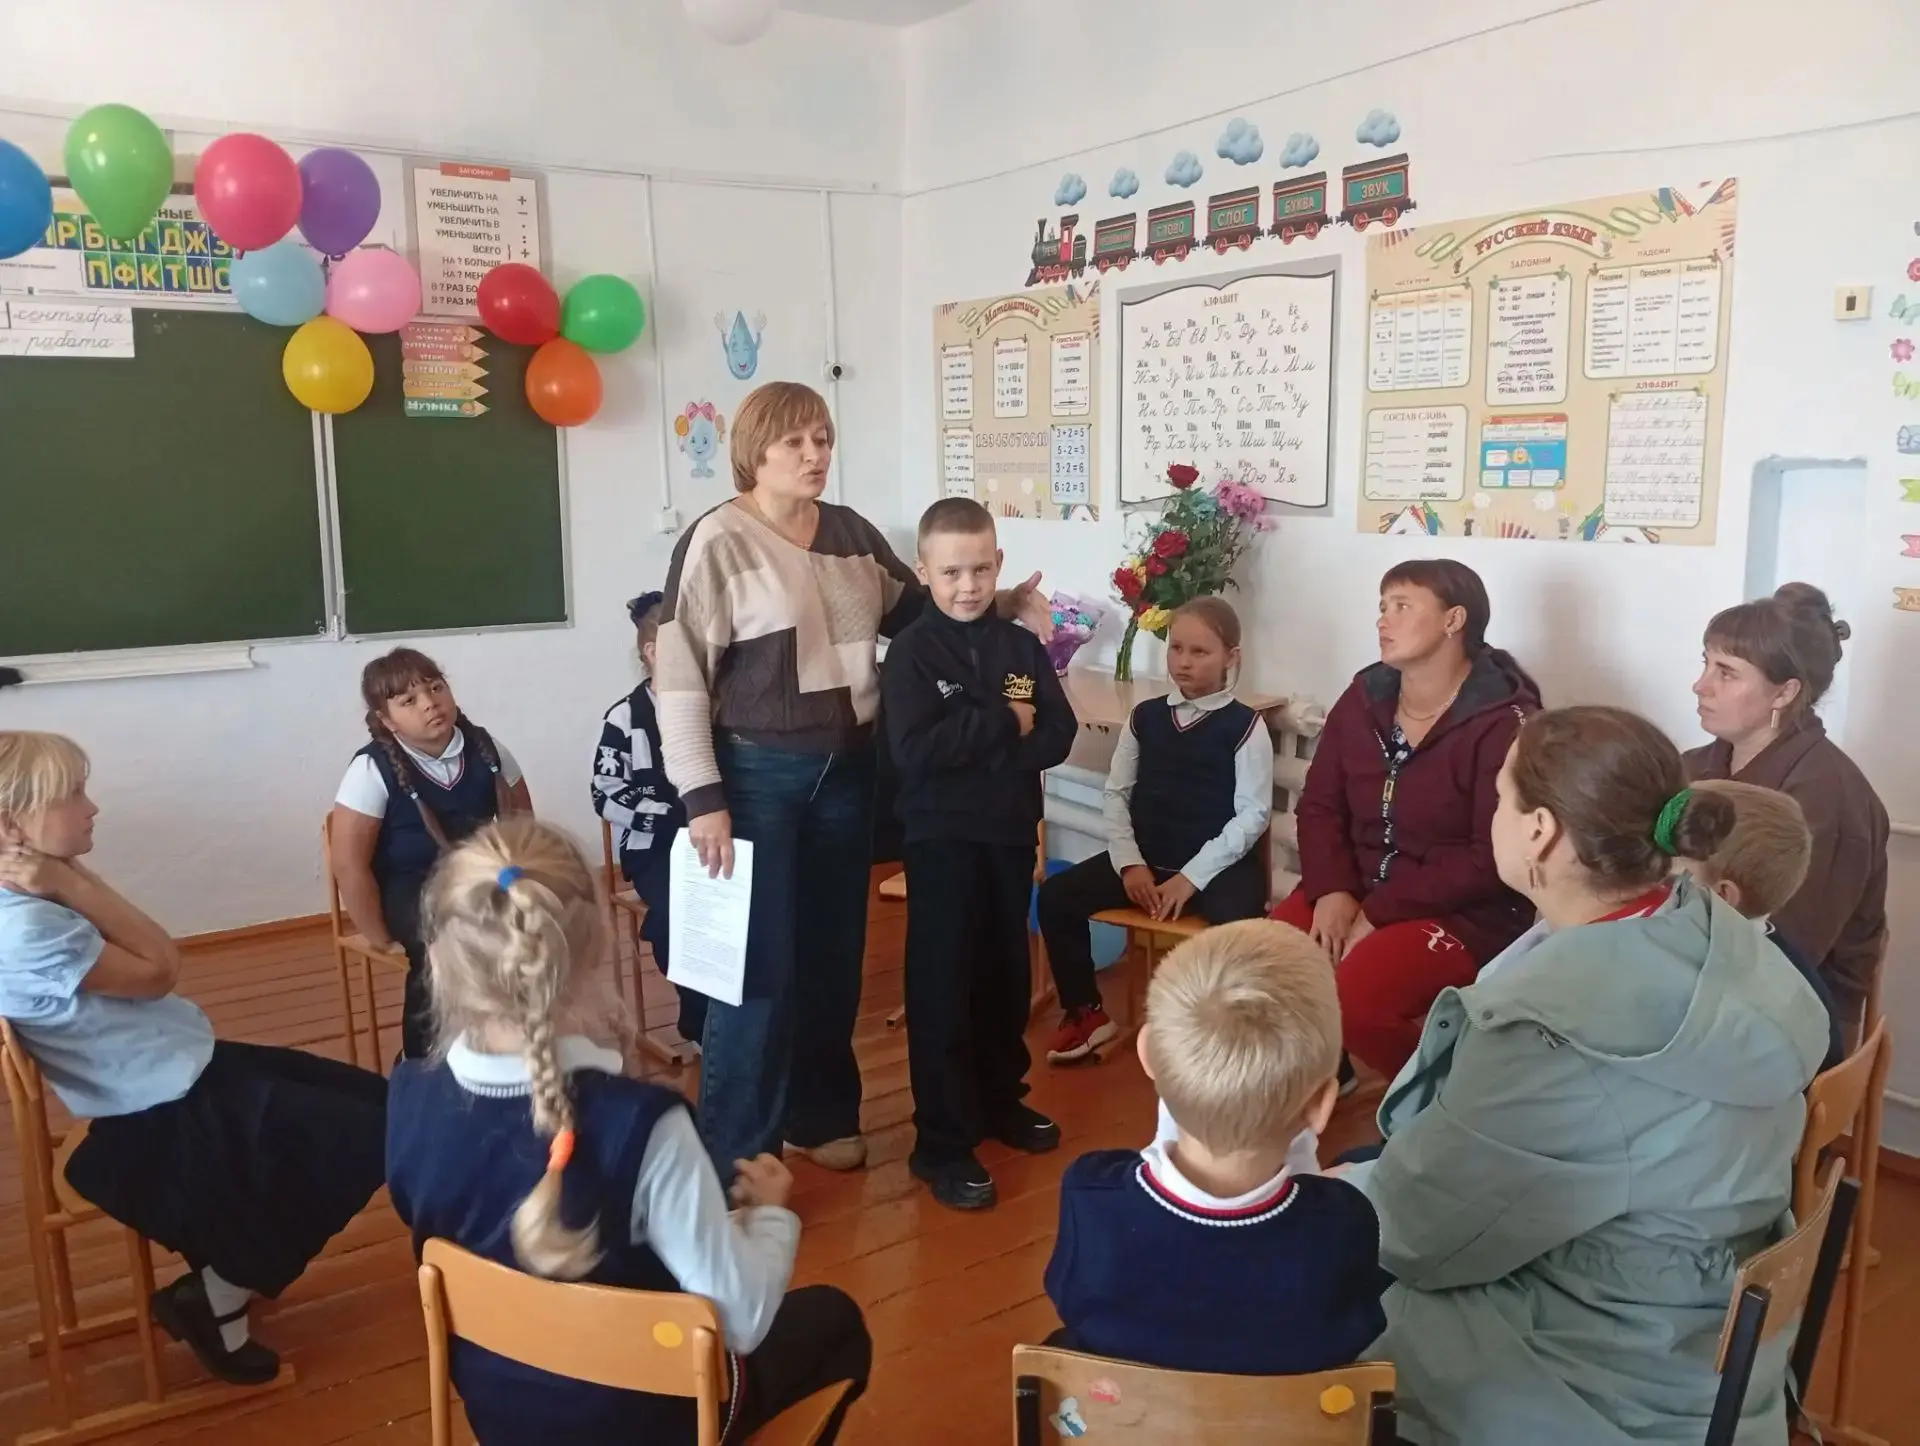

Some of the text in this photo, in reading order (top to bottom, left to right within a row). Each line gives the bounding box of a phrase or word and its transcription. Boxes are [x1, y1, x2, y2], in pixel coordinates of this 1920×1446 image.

[430, 188, 484, 200] УВЕЛИЧИТЬ
[485, 193, 498, 201] НА
[1360, 180, 1391, 199] ЗВУК
[427, 201, 499, 215] УМЕНЬШИТЬ НА
[1284, 196, 1315, 213] БУКВА
[438, 216, 500, 228] УВЕЛИЧИТЬ В
[1217, 208, 1248, 226] СЛОГ
[435, 229, 501, 241] УМЕНЬШИТЬ В
[1474, 218, 1597, 256] РУССКИЙ ЯЗЫК
[472, 244, 501, 255] ВСЕГО
[442, 256, 455, 264] НА
[1509, 256, 1552, 269] ЗАПОМНИ
[443, 270, 456, 278] НА
[446, 283, 464, 292] РАЗ
[446, 296, 464, 305] РАЗ
[25, 330, 114, 354] работа
[1635, 380, 1680, 389] АЛФАВИТ
